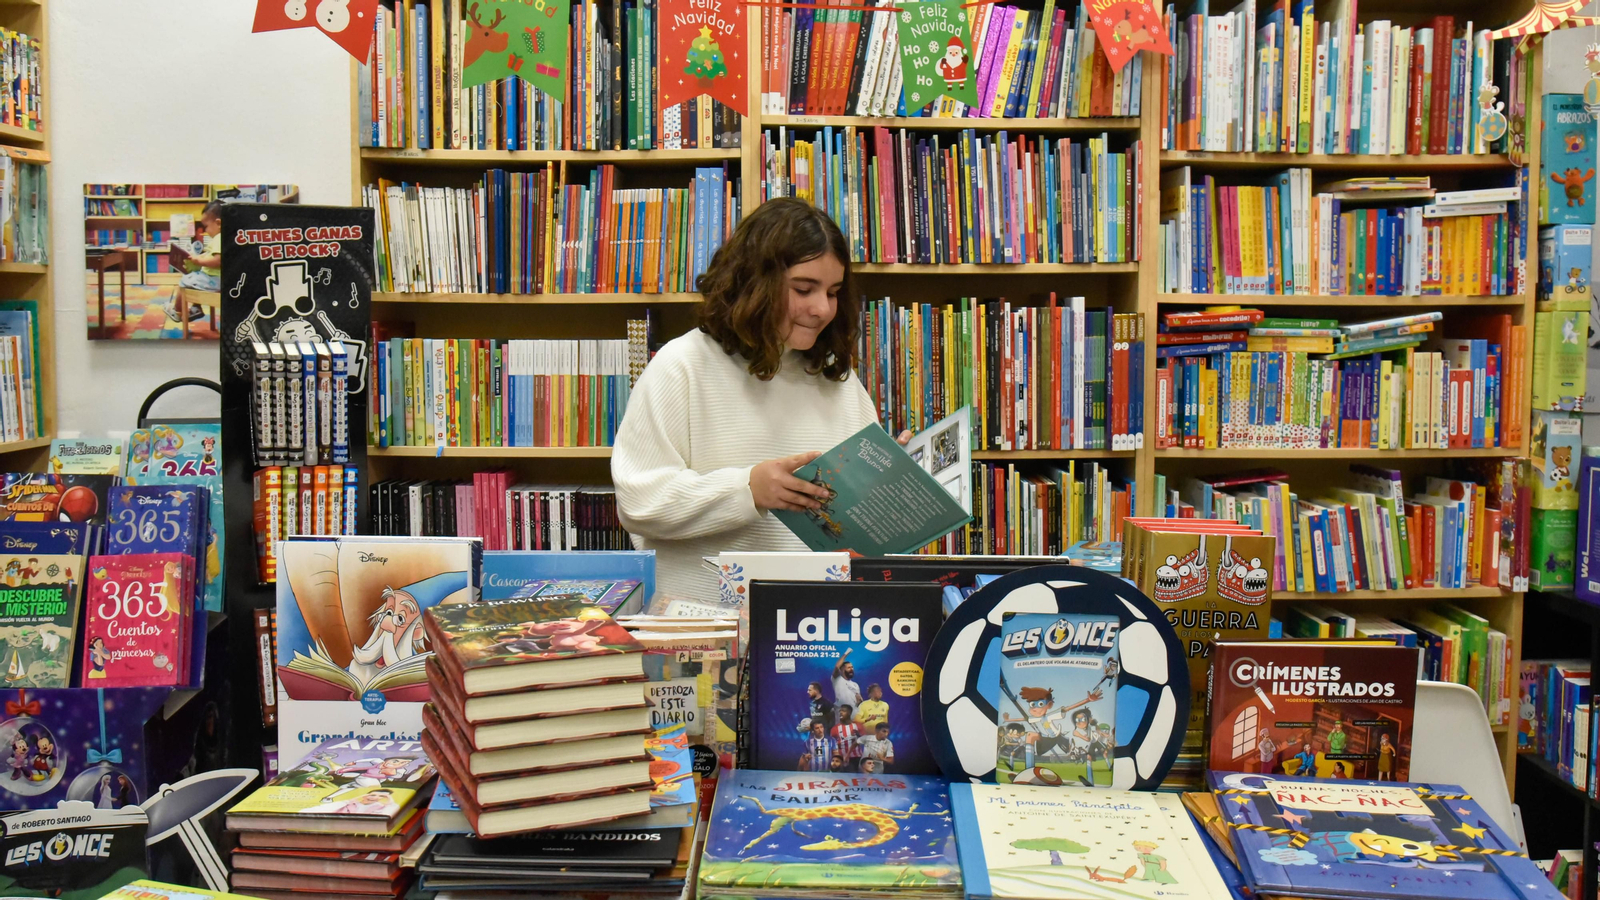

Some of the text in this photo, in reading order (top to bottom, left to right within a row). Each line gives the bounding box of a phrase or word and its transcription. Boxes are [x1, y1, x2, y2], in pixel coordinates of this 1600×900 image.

[689, 0, 722, 13] Feliz
[918, 3, 948, 19] Feliz
[673, 10, 736, 35] Navidad
[909, 17, 963, 39] Navidad
[903, 44, 921, 57] Ho
[913, 56, 930, 69] Ho
[1011, 60, 1023, 86] ESCUELA
[916, 75, 933, 88] Ho
[1556, 112, 1592, 124] ABRAZOS
[234, 225, 362, 245] ¿TIENES GANAS
[258, 241, 341, 260] DE ROCK?
[307, 393, 315, 404] Greg
[857, 447, 882, 472] Bruno
[860, 436, 893, 469] Brunilda
[161, 461, 217, 476] 365
[7, 484, 59, 499] SPIDER-MAN
[6, 501, 54, 512] CUENTOS DE
[136, 495, 163, 507] Disney
[115, 508, 181, 544] 365
[1, 532, 38, 551] Disney
[357, 551, 389, 565] Disney
[0, 588, 63, 603] DESCUBRE
[98, 580, 168, 620] 365
[487, 595, 567, 607] ROWLING
[5, 601, 67, 617] MISTERIO!
[1206, 601, 1217, 609] LA
[1163, 609, 1260, 631] GUERRA
[107, 620, 163, 639] Cuentos
[776, 607, 920, 651] LaLiga
[1001, 618, 1121, 653] LOS ONCE
[1181, 630, 1194, 638] DE
[126, 637, 137, 647] de
[111, 646, 156, 663] princesas
[678, 651, 686, 661] A
[1236, 661, 1342, 681] CRÍMENES
[650, 685, 695, 697] DESTROZA
[1271, 681, 1396, 698] ILUSTRADOS
[661, 698, 686, 710] ESTE
[360, 719, 375, 728] Gran
[652, 710, 695, 725] DIARIO
[739, 777, 907, 792] LAS JIRAFAS
[844, 786, 893, 794] PUEDEN
[1280, 784, 1336, 792] BUENAS
[770, 793, 862, 804] BAILAR
[987, 796, 1145, 812] Mi primer Principito
[1277, 789, 1425, 810] ÑAC-ÑAC
[11, 815, 92, 830] de ROBERTO SANTIAGO
[562, 832, 662, 842] BANDIDOS
[5, 832, 114, 867] LOS ONCE
[1319, 869, 1376, 879] EMMA
